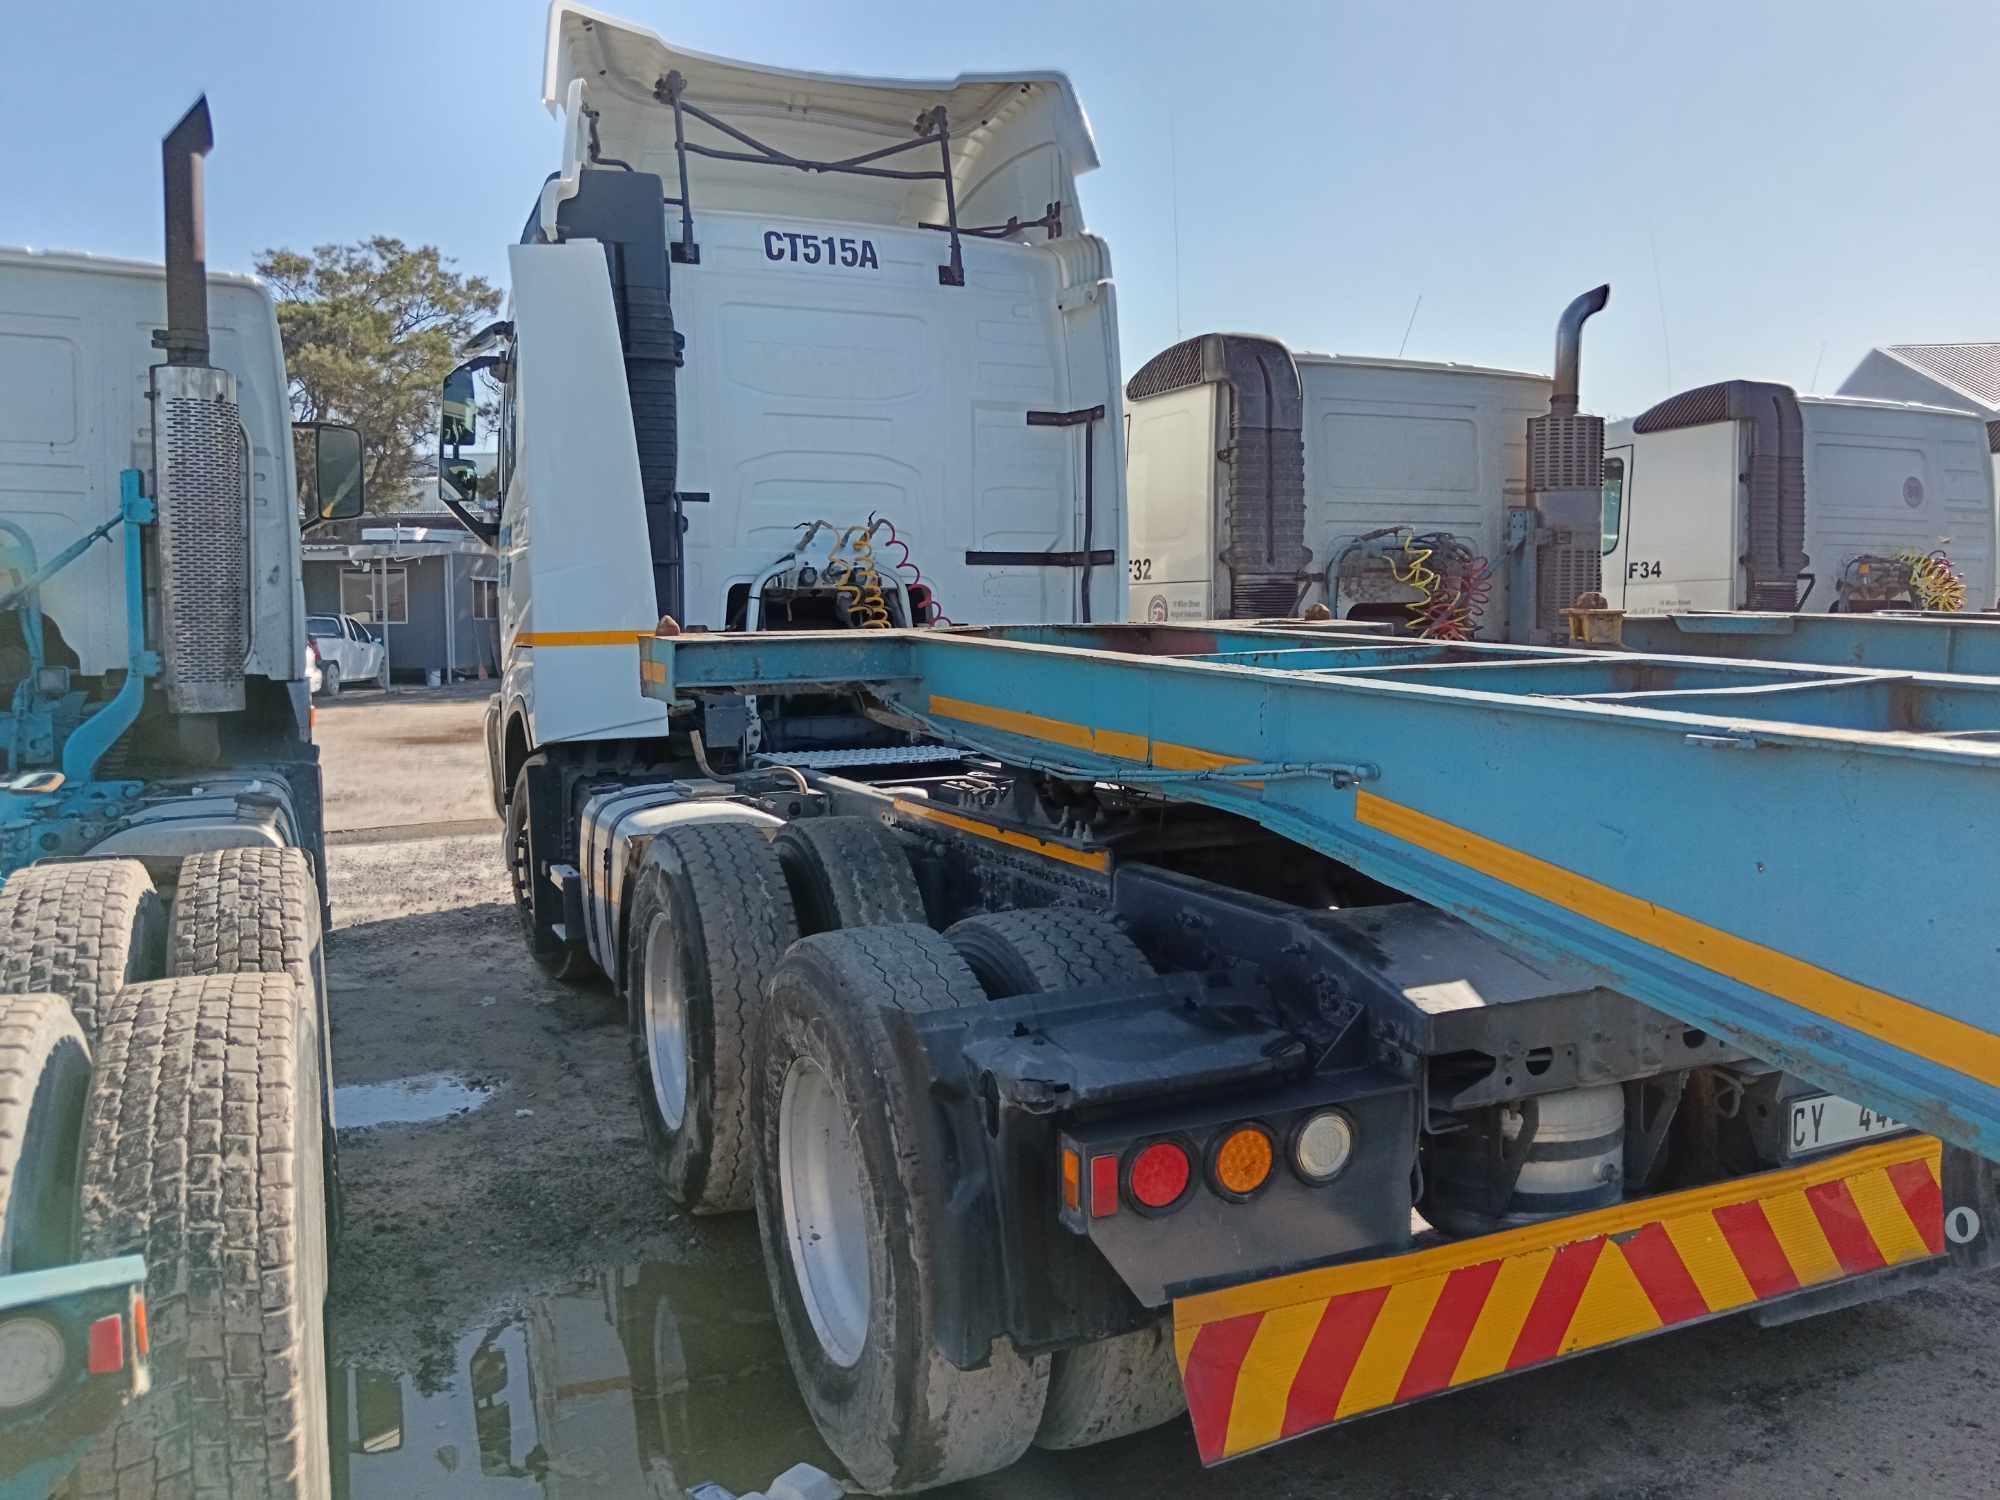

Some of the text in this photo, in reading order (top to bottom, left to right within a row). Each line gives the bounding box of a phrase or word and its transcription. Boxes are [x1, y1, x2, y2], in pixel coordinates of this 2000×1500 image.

[763, 230, 879, 270] CT515A
[1628, 560, 1662, 579] F34
[1793, 1103, 1903, 1147] CY 44
